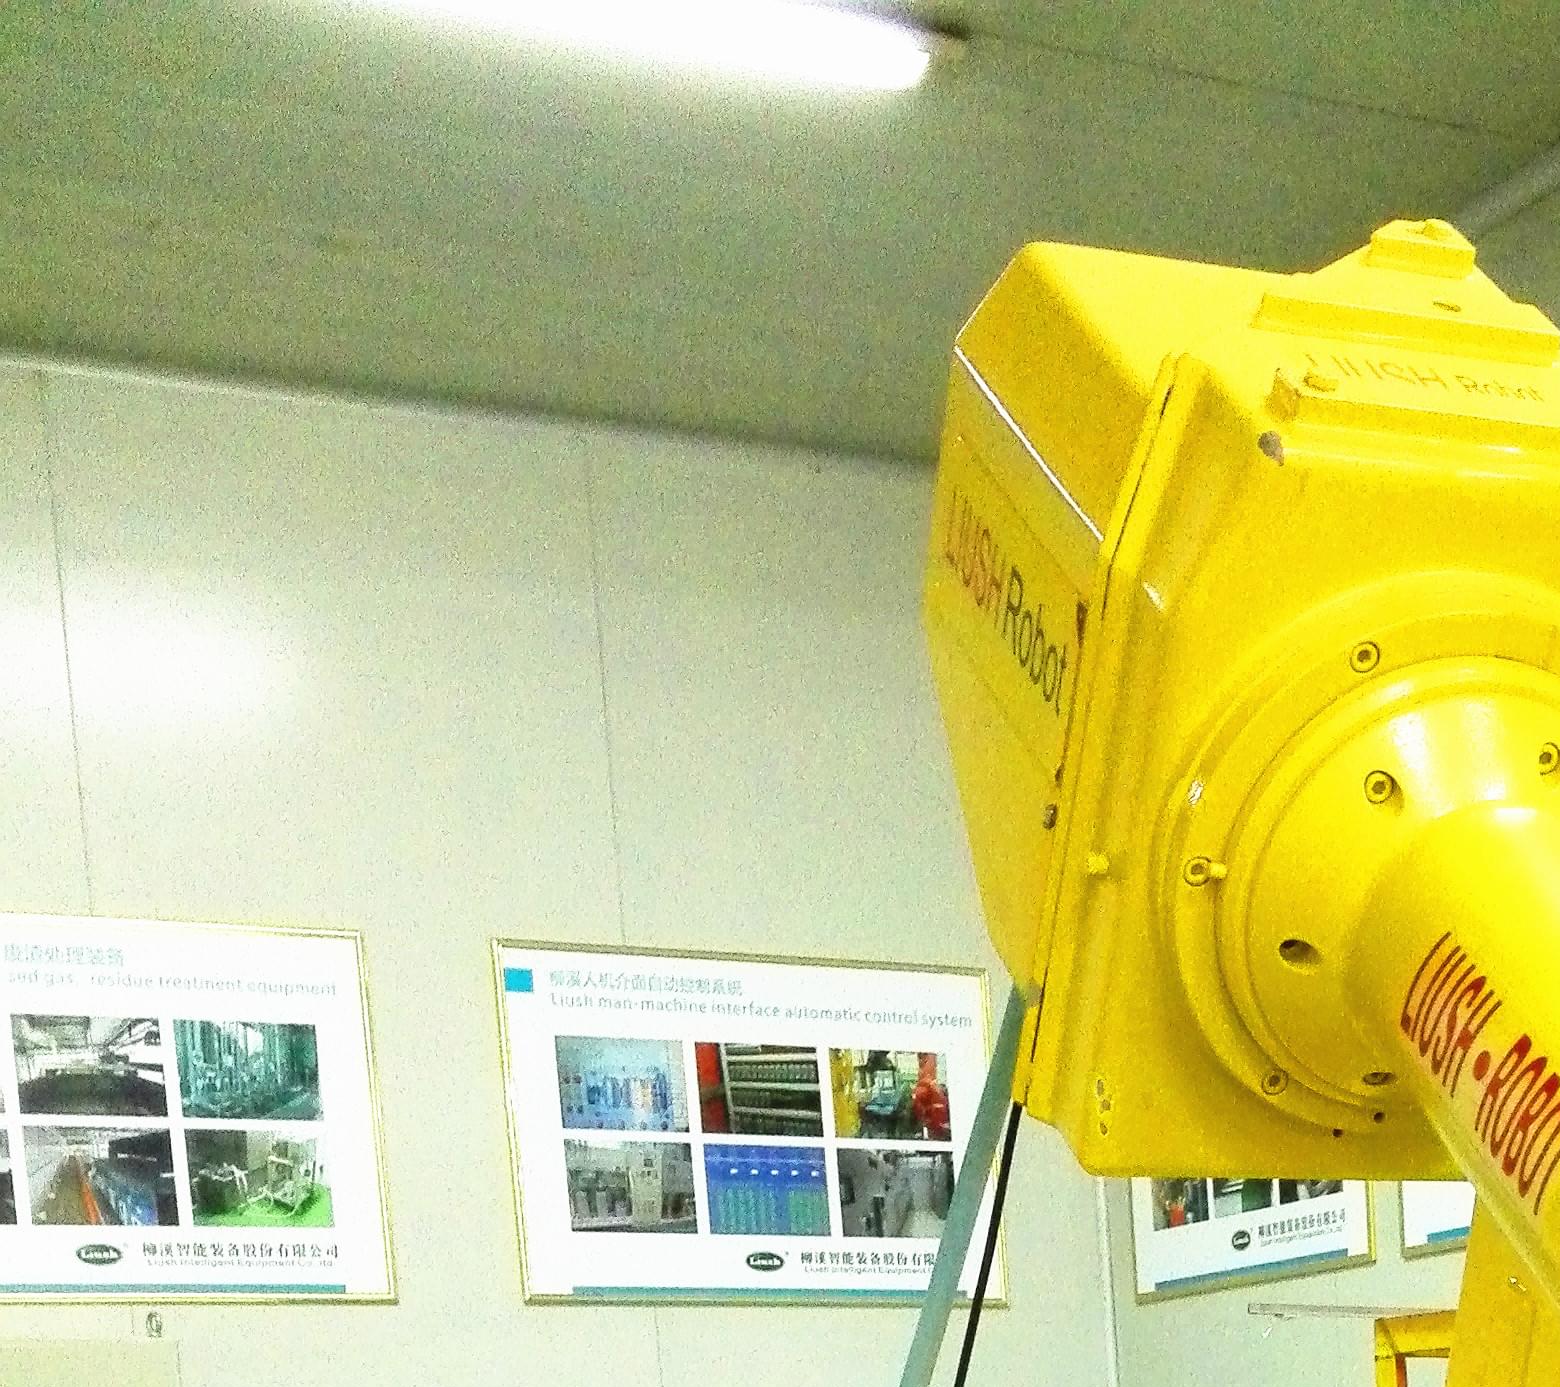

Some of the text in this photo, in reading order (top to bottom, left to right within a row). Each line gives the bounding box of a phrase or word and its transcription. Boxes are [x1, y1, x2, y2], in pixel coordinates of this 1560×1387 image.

[945, 486, 1068, 717] LIUSH Robot
[711, 998, 780, 1017] interface
[785, 1004, 860, 1022] automatic
[865, 1009, 918, 1025] control
[921, 1012, 973, 1029] system
